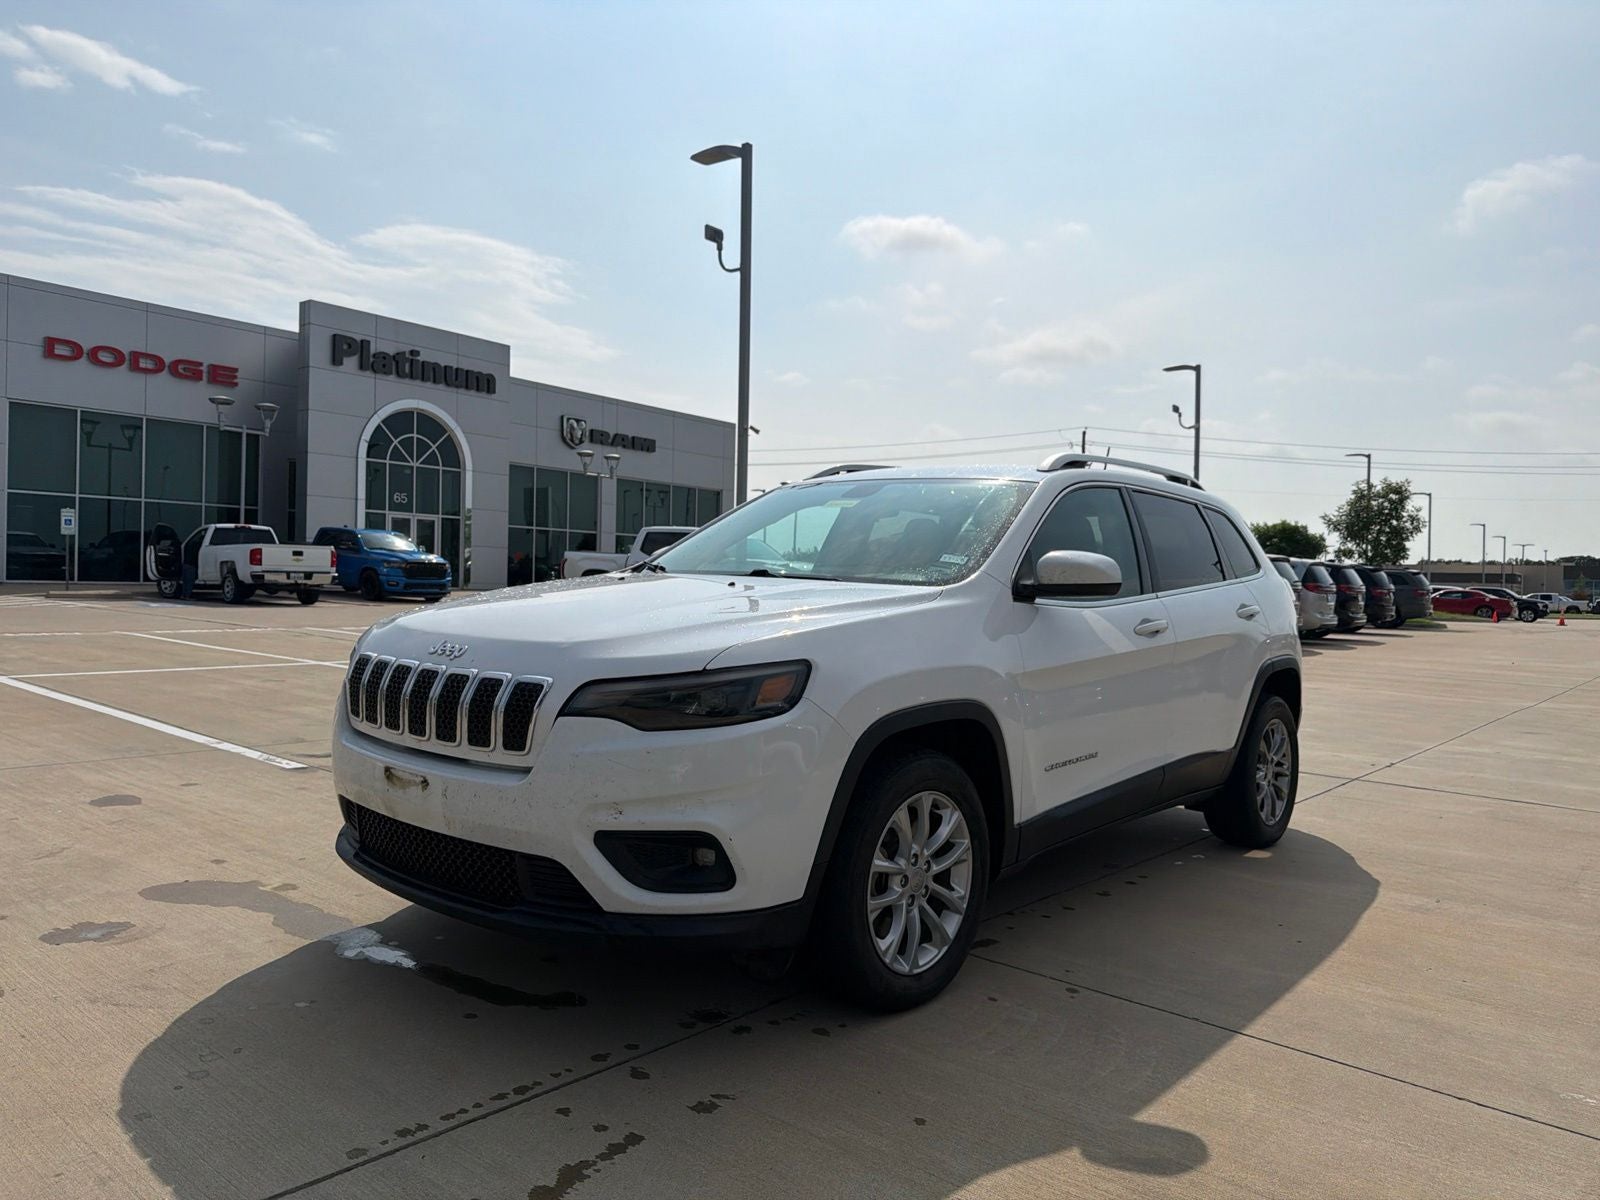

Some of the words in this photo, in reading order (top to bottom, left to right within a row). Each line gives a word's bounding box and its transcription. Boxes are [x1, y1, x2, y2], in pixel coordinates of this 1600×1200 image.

[43, 336, 239, 388] DODGE
[331, 333, 497, 395] Platinum
[588, 428, 656, 453] RAM
[394, 492, 408, 503] 65
[428, 640, 469, 661] Jeep
